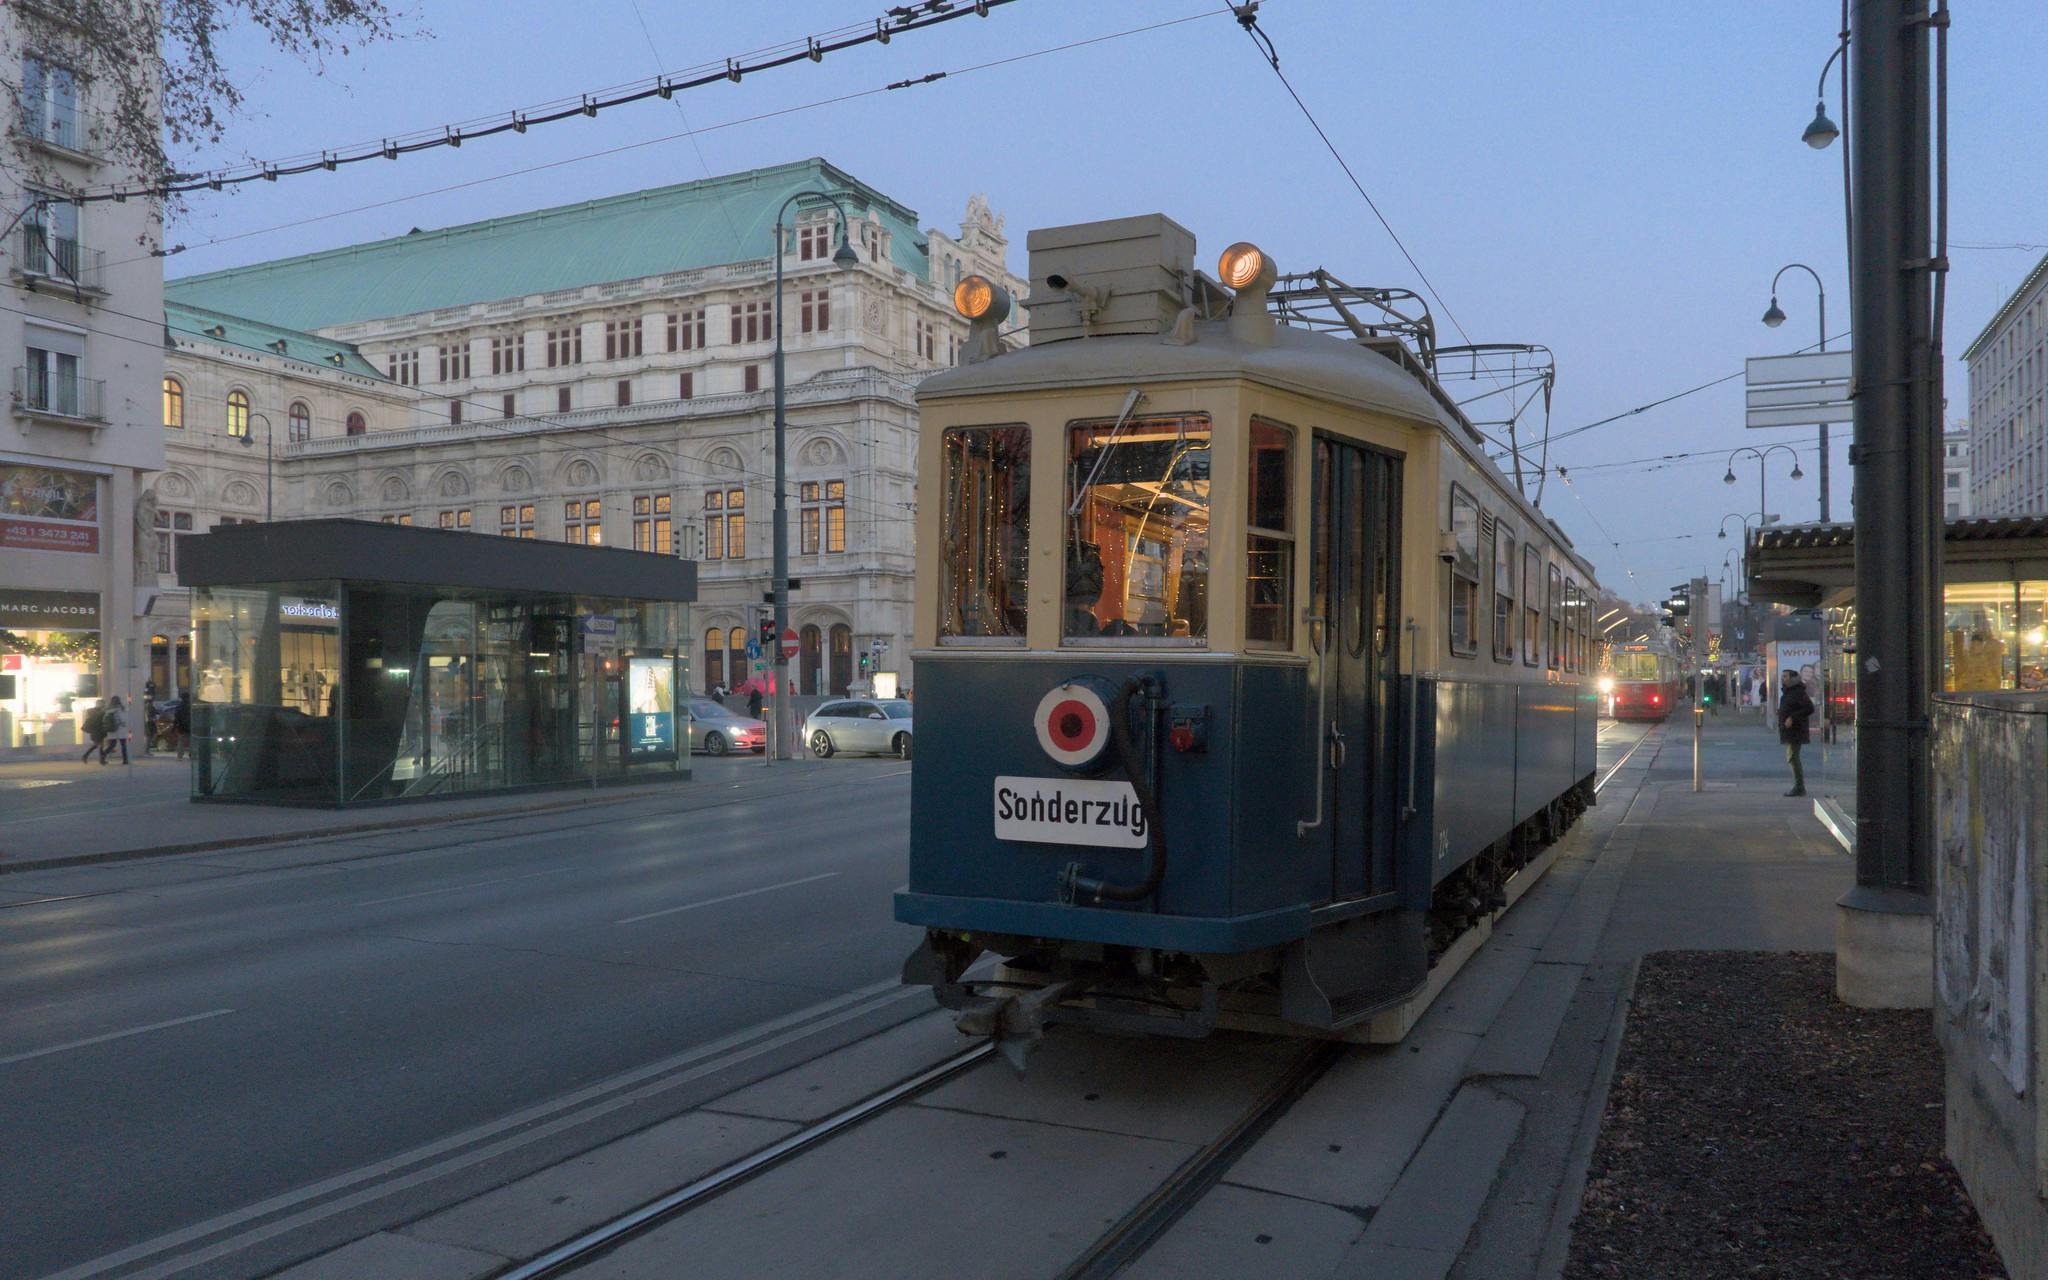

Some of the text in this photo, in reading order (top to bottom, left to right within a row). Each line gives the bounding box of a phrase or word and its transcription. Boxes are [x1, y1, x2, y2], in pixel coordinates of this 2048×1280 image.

[1, 604, 96, 615] MARC JACOBS
[1783, 647, 1807, 656] WHY
[998, 787, 1146, 837] Sonderzug
